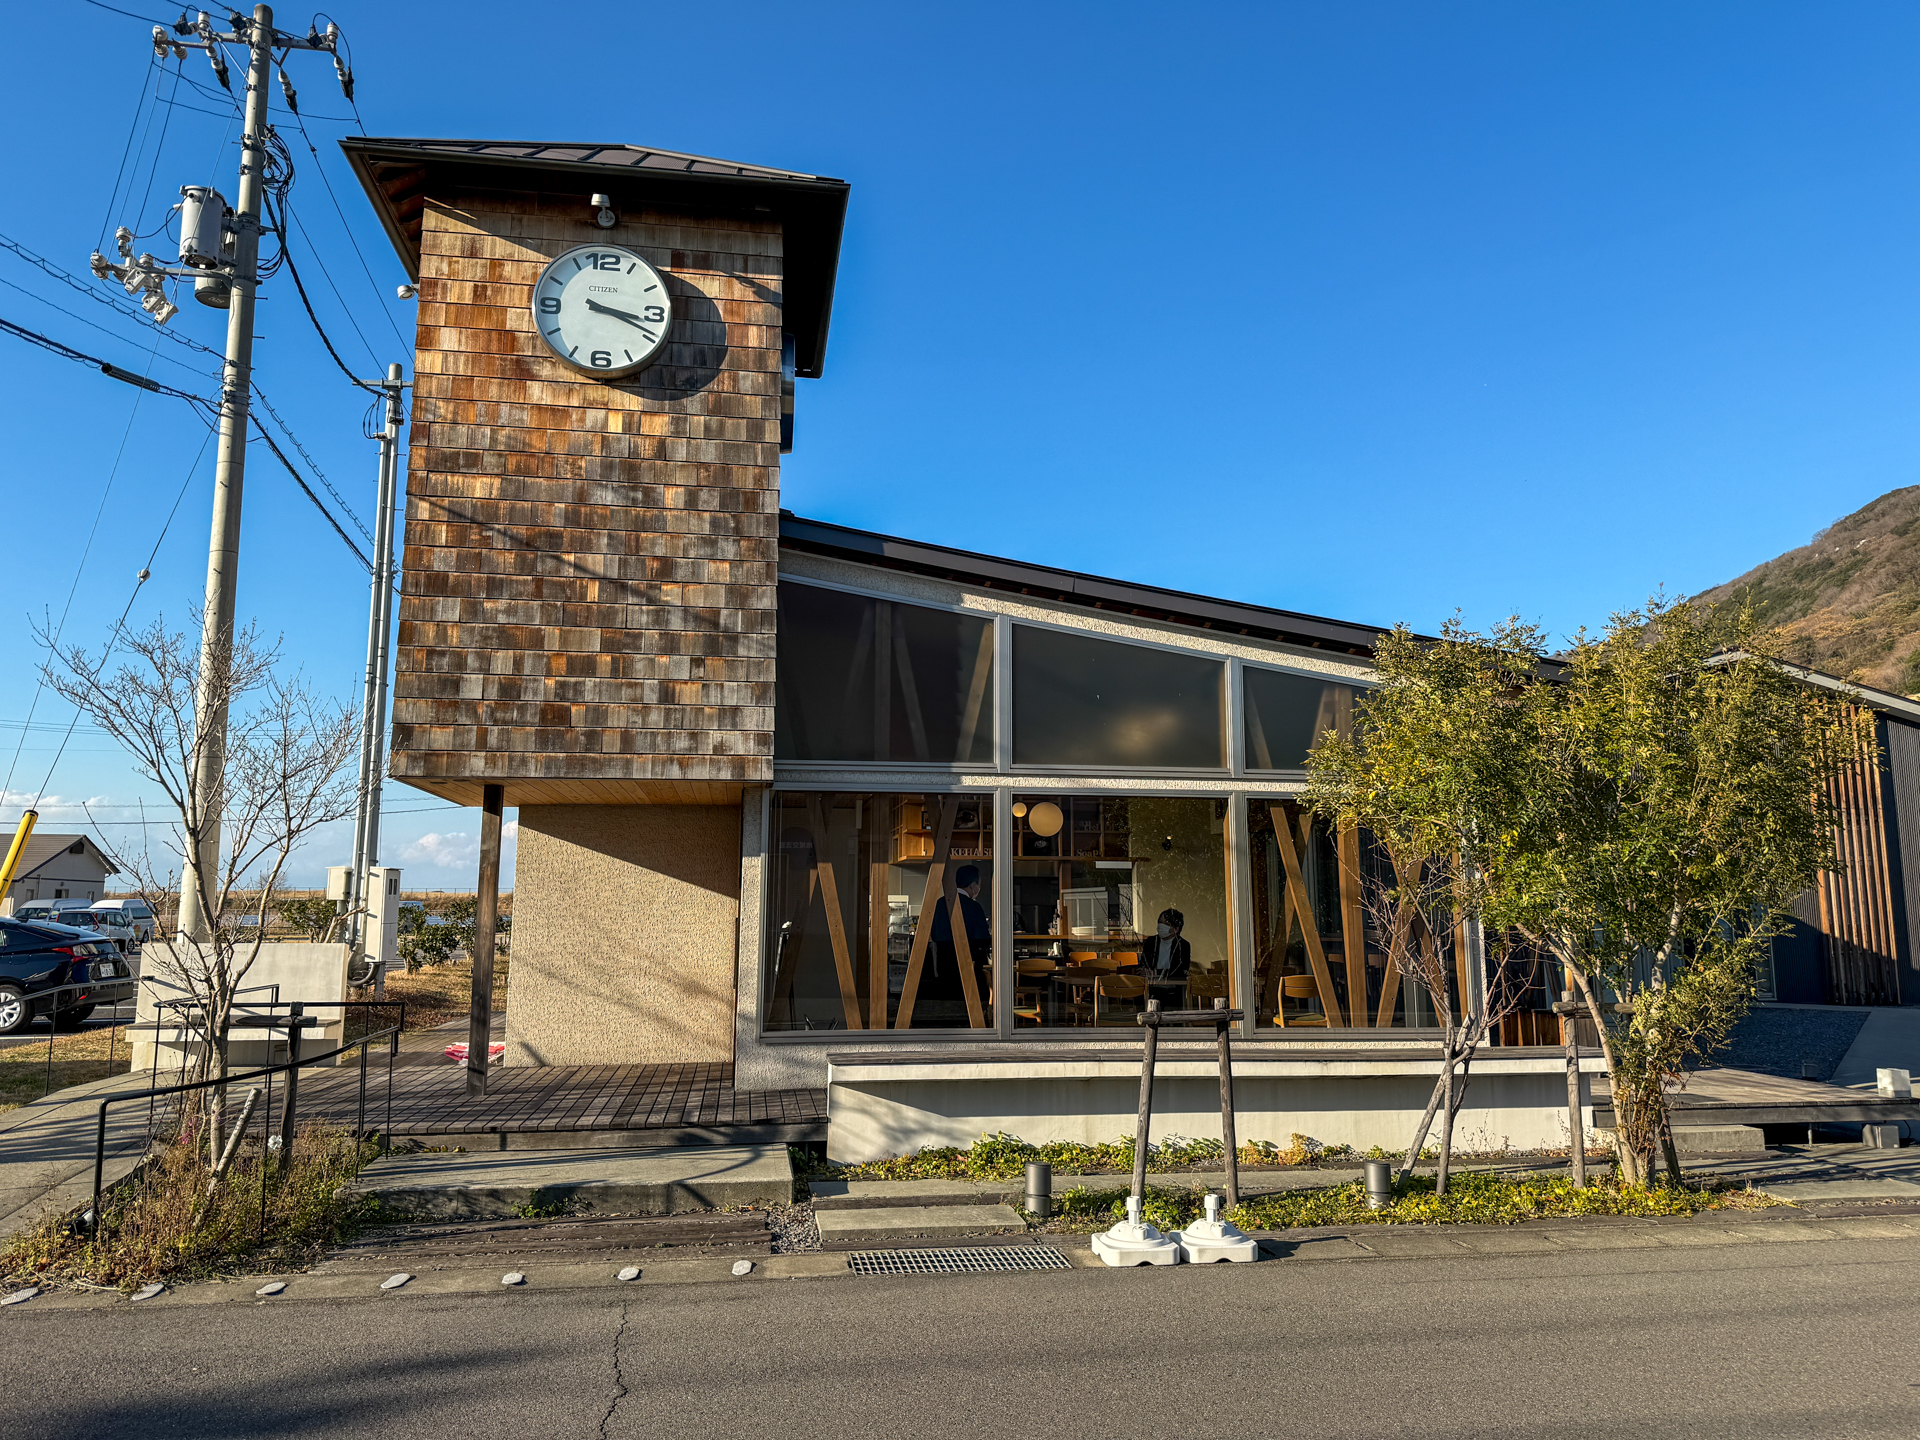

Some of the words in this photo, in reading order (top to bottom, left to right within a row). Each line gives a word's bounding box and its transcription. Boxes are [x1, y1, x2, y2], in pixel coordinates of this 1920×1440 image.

[585, 252, 621, 272] 12
[588, 285, 618, 293] CITIZEN
[540, 297, 562, 315] 9
[644, 305, 665, 323] 3
[590, 350, 612, 368] 6
